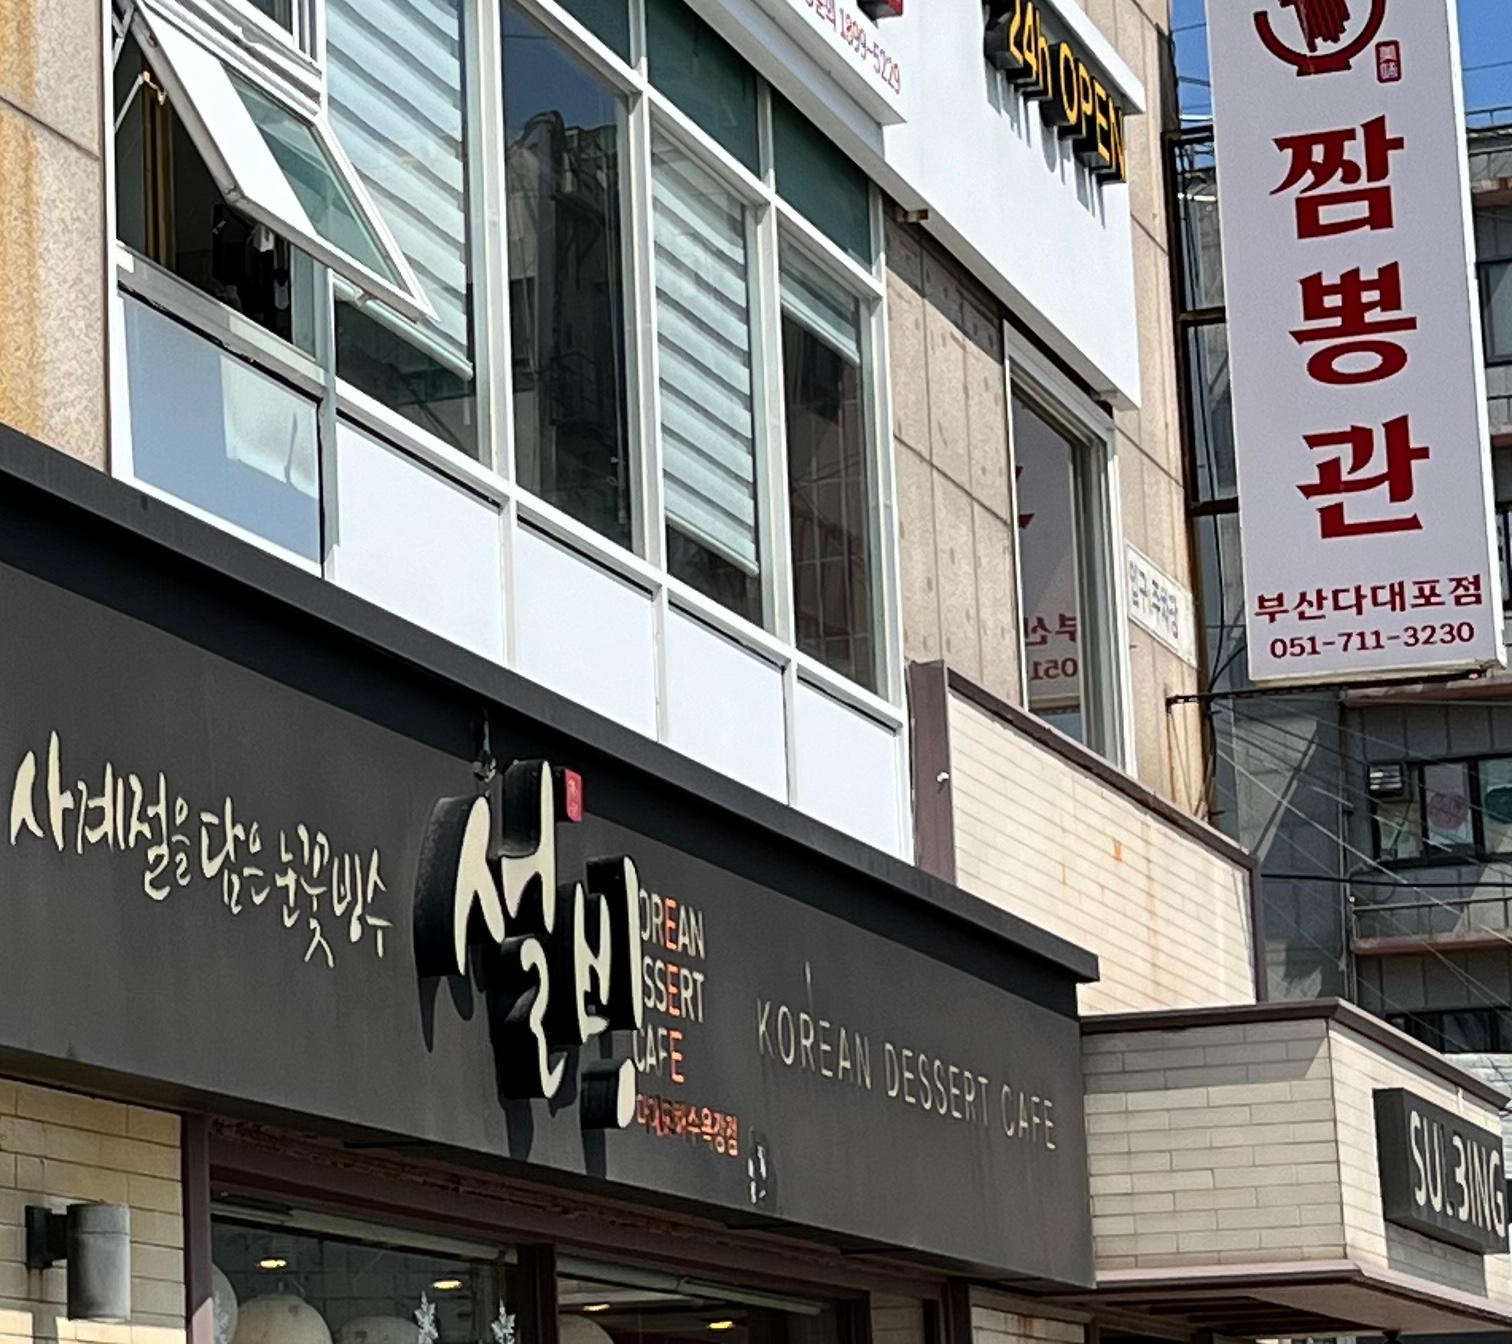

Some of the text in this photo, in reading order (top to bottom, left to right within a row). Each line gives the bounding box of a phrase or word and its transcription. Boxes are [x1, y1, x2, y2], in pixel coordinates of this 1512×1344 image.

[1059, 41, 1127, 183] OPEN
[1269, 113, 1431, 539] 짬뽕관
[1254, 572, 1483, 623] 부산다대포점
[1269, 622, 1475, 659] 051-711-3230
[453, 760, 644, 1129] 설빙
[639, 887, 705, 961] OREAN
[641, 954, 705, 1023] SSERT
[756, 998, 1056, 1150] KOREAN DESSERT CAFE
